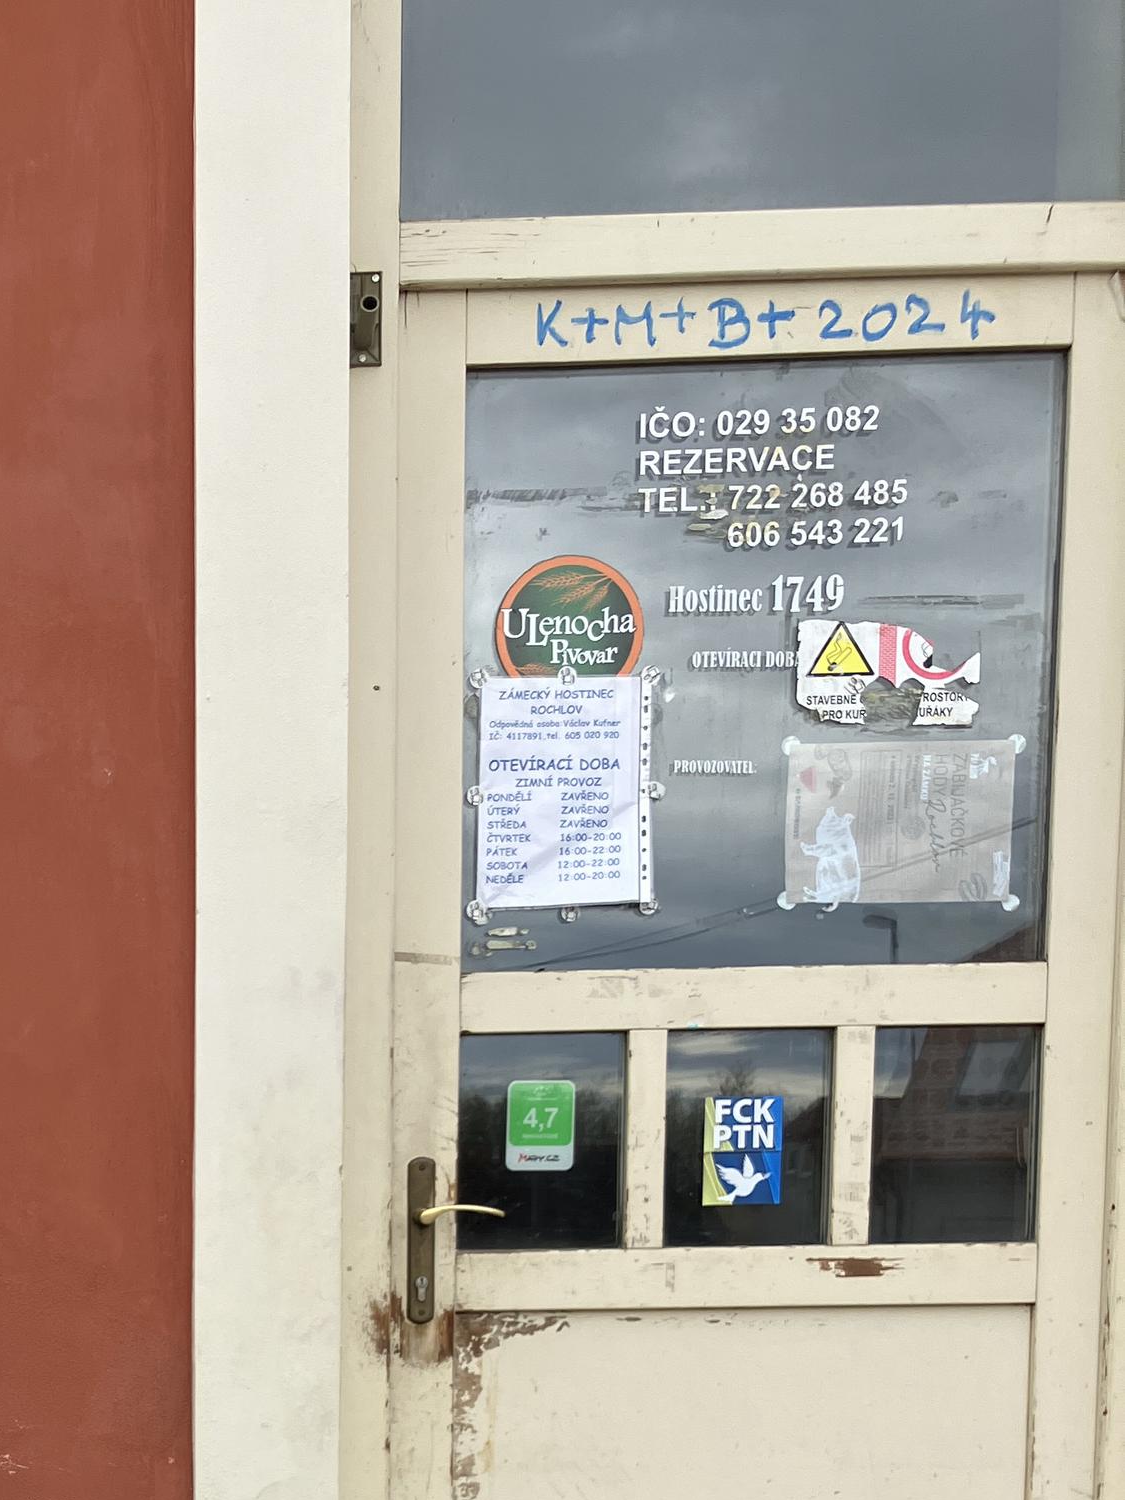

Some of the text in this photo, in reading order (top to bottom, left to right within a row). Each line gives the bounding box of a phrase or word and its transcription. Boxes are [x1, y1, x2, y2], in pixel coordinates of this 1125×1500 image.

[818, 288, 996, 341] 2024
[639, 405, 880, 439] IČO: 029 35 082
[639, 444, 835, 476] REZERVACE
[728, 484, 781, 511] 722
[791, 481, 844, 509] 268
[853, 478, 908, 506] 485
[727, 516, 904, 548] 606 543 221
[668, 574, 845, 613] Hostinec 1749
[550, 639, 618, 666] Pivovar
[499, 687, 615, 701] ZÁMECKÝ HOSTINEC
[922, 691, 969, 702] ROSTOR
[530, 704, 583, 715] ROCHLOV
[822, 709, 843, 719] PRO
[917, 706, 954, 718] UŘÁKY
[489, 754, 620, 772] OTEVÍRACÍ DOBA
[515, 775, 603, 788] ZIMNÍ PROVOZ
[487, 790, 609, 802] PONDĚLÍ ZAVŘENO
[487, 804, 609, 816] ÚTERÝ ZAVŘENO
[486, 818, 608, 830] STŘEDA ZAVŘENO
[486, 832, 531, 843] ČTVRTEK
[486, 846, 518, 857] PÁTEK
[486, 861, 528, 870] SOBOTA
[485, 873, 524, 884] NEDĚLE
[714, 1098, 776, 1124] FCK
[522, 1106, 559, 1132] 4,7
[713, 1124, 775, 1149] PTN
